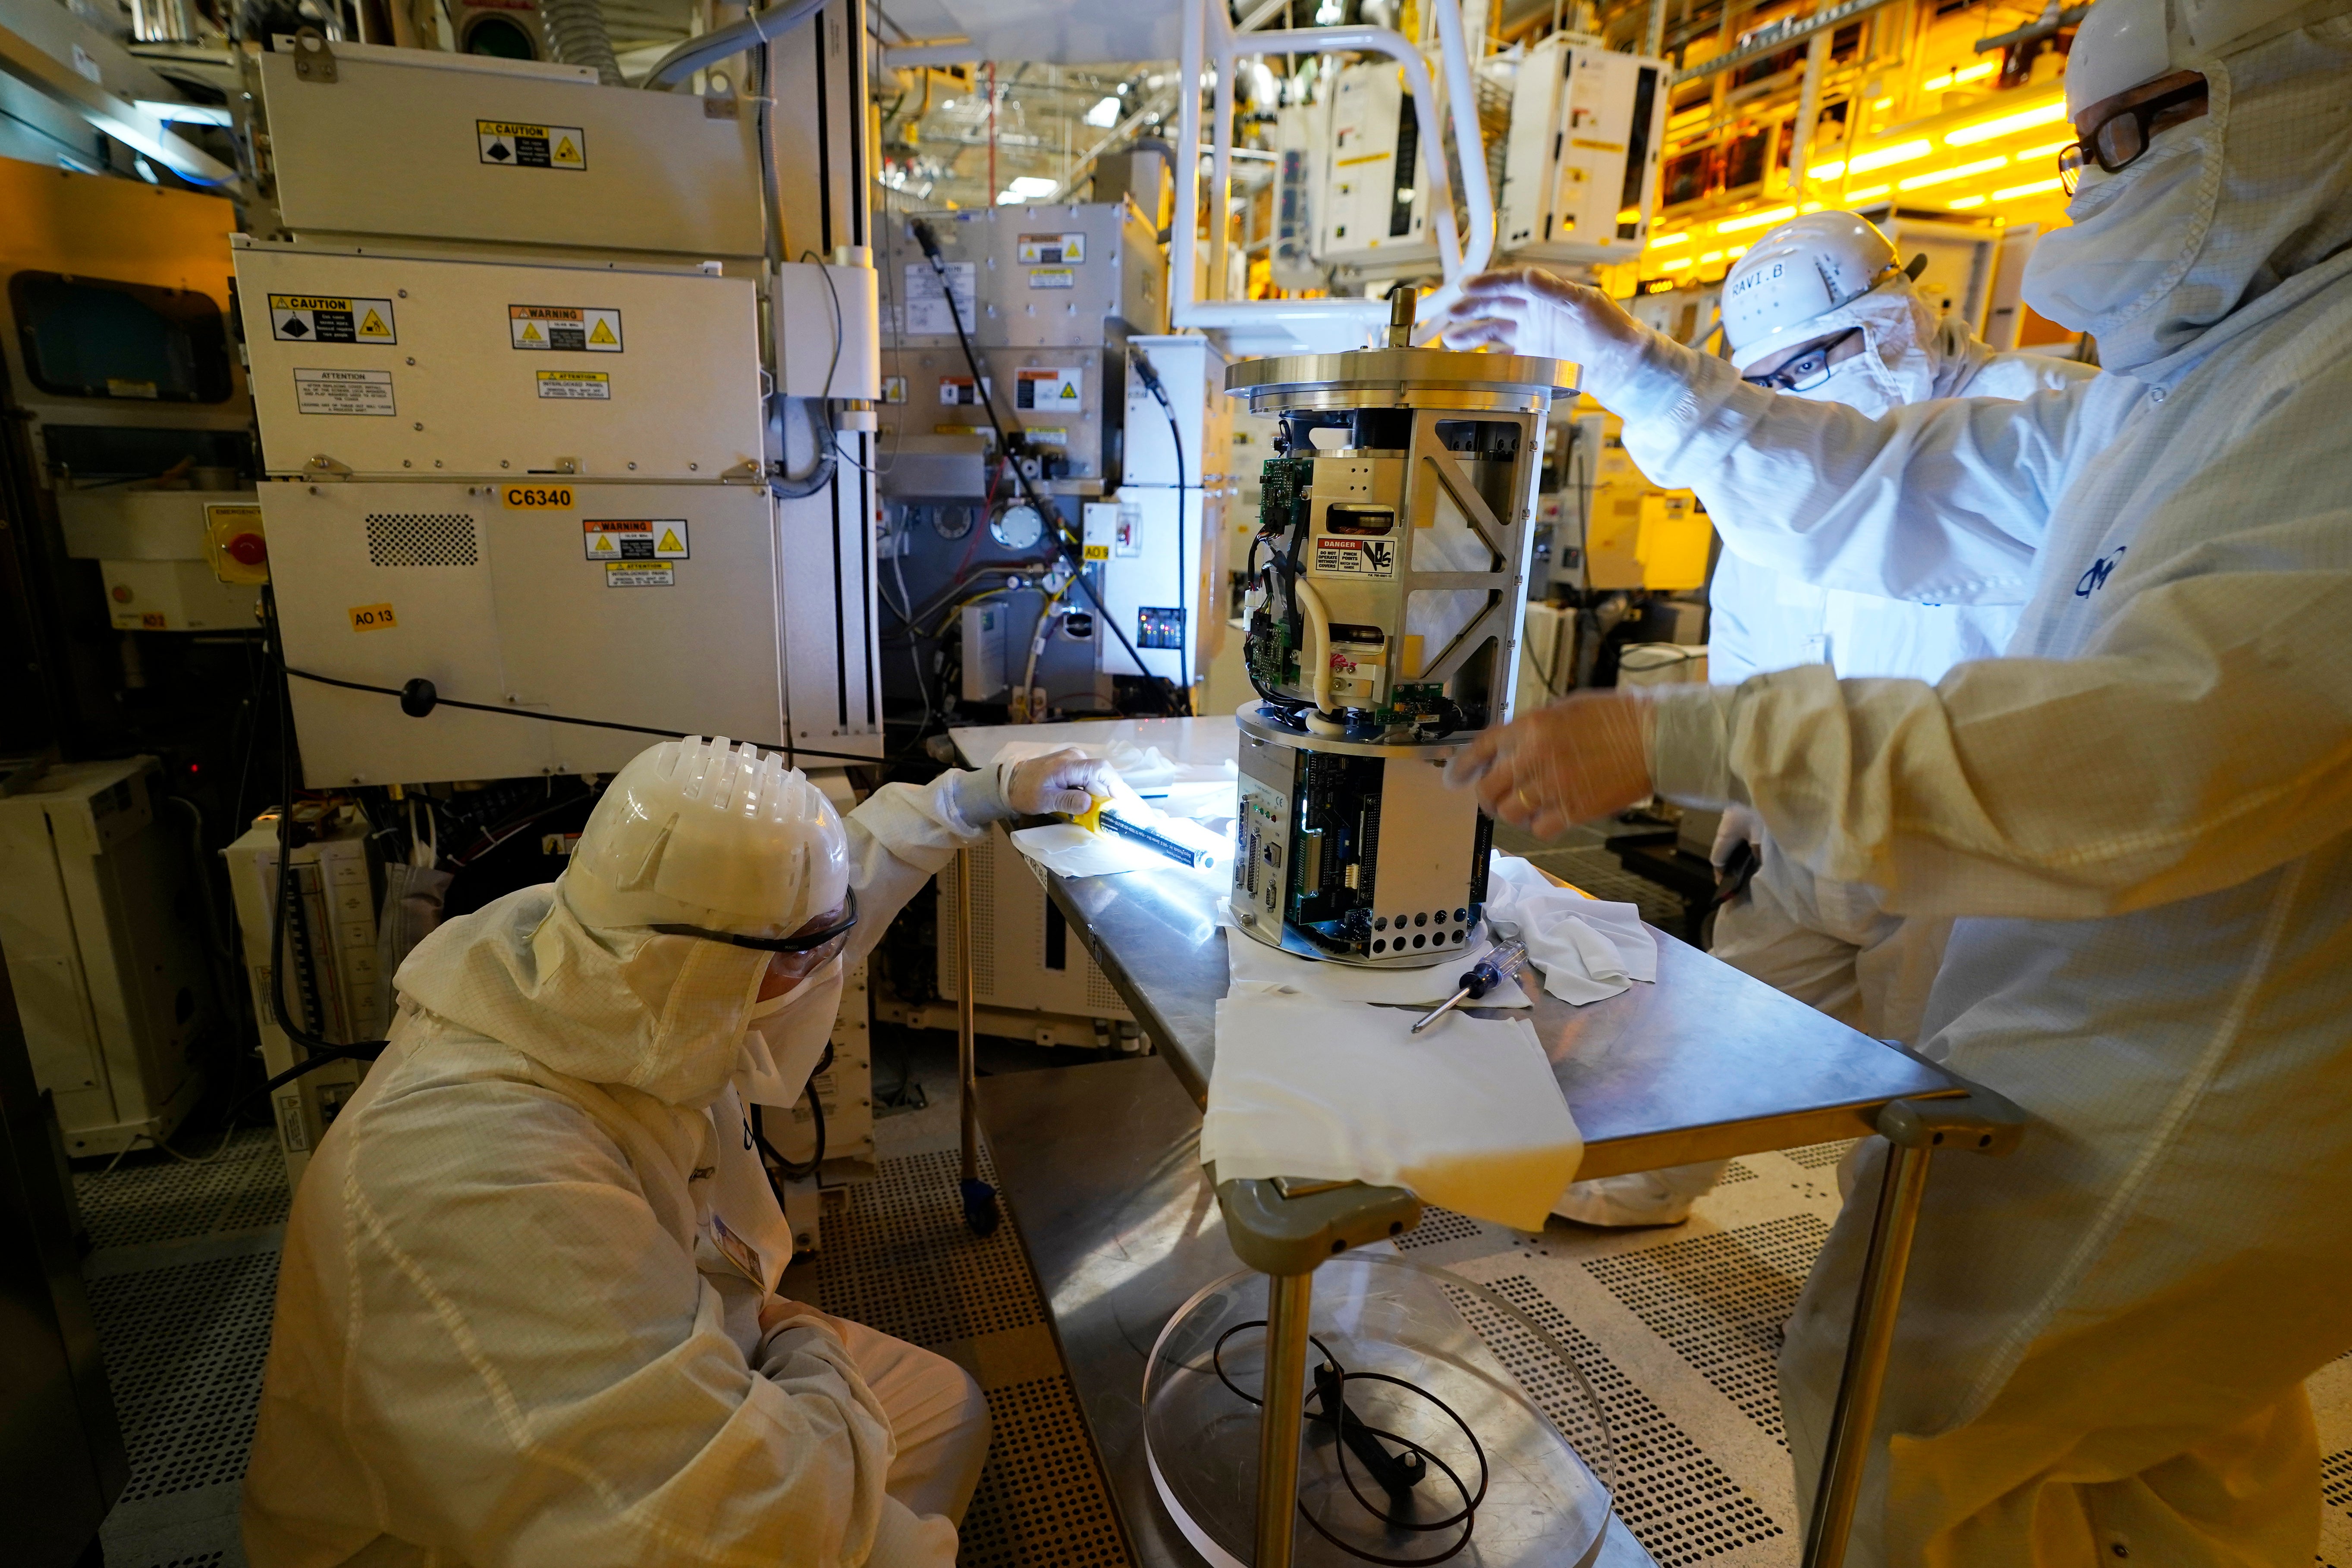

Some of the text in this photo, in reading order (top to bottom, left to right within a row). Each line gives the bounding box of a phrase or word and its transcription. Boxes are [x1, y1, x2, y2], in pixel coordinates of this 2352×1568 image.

[496, 124, 543, 136] CAUTION
[291, 298, 346, 309] CAUTION
[529, 309, 577, 319] WARNING
[509, 489, 570, 505] C6340
[601, 522, 647, 530] WARNING
[356, 610, 393, 625] AO 13
